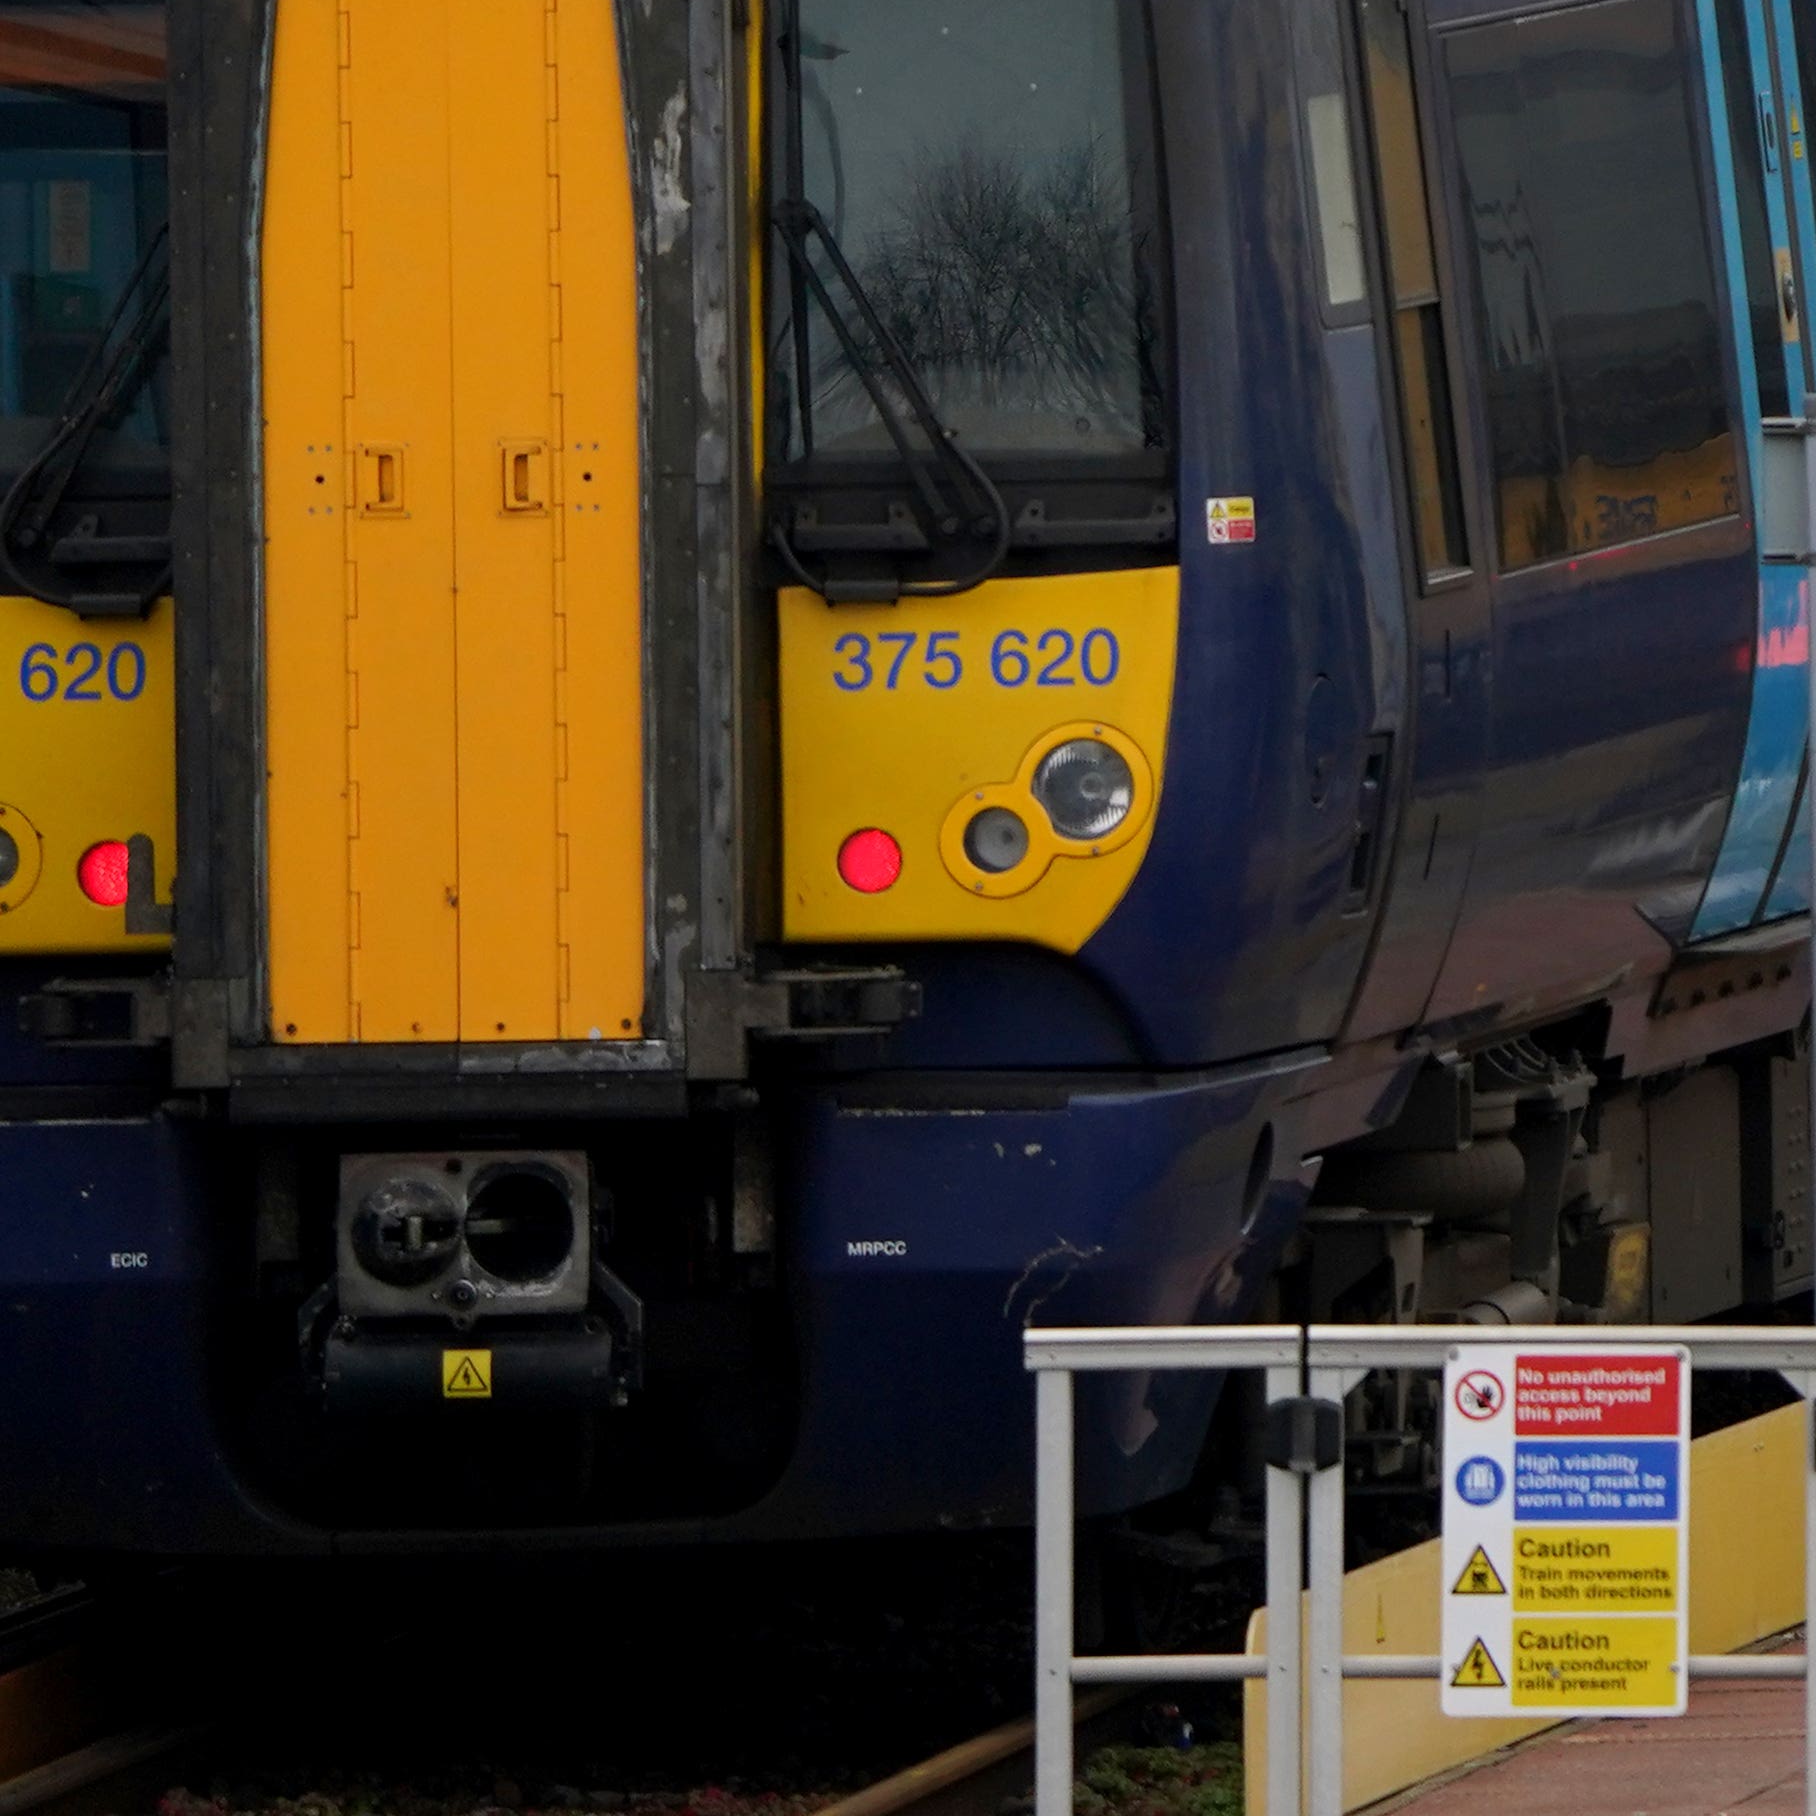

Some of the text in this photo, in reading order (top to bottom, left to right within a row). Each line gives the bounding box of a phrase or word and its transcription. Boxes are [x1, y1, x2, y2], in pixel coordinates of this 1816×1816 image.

[833, 627, 1120, 691] 375 620
[19, 642, 147, 702] 620
[847, 1240, 907, 1256] MRPCC
[110, 1252, 148, 1269] ECIC
[1518, 1367, 1666, 1384] No unauthorised
[1518, 1386, 1651, 1407] access beyond
[1517, 1405, 1602, 1424] this point
[1517, 1453, 1638, 1474] High visibility
[1517, 1472, 1666, 1493] clothing must be
[1517, 1491, 1665, 1507] worn in this area
[1519, 1538, 1611, 1558] Caution
[1519, 1566, 1670, 1581] Train movements
[1519, 1584, 1672, 1599] in both directions
[1518, 1630, 1610, 1650] Caution
[1518, 1657, 1649, 1672] Live conductor
[1518, 1676, 1627, 1694] rails present
